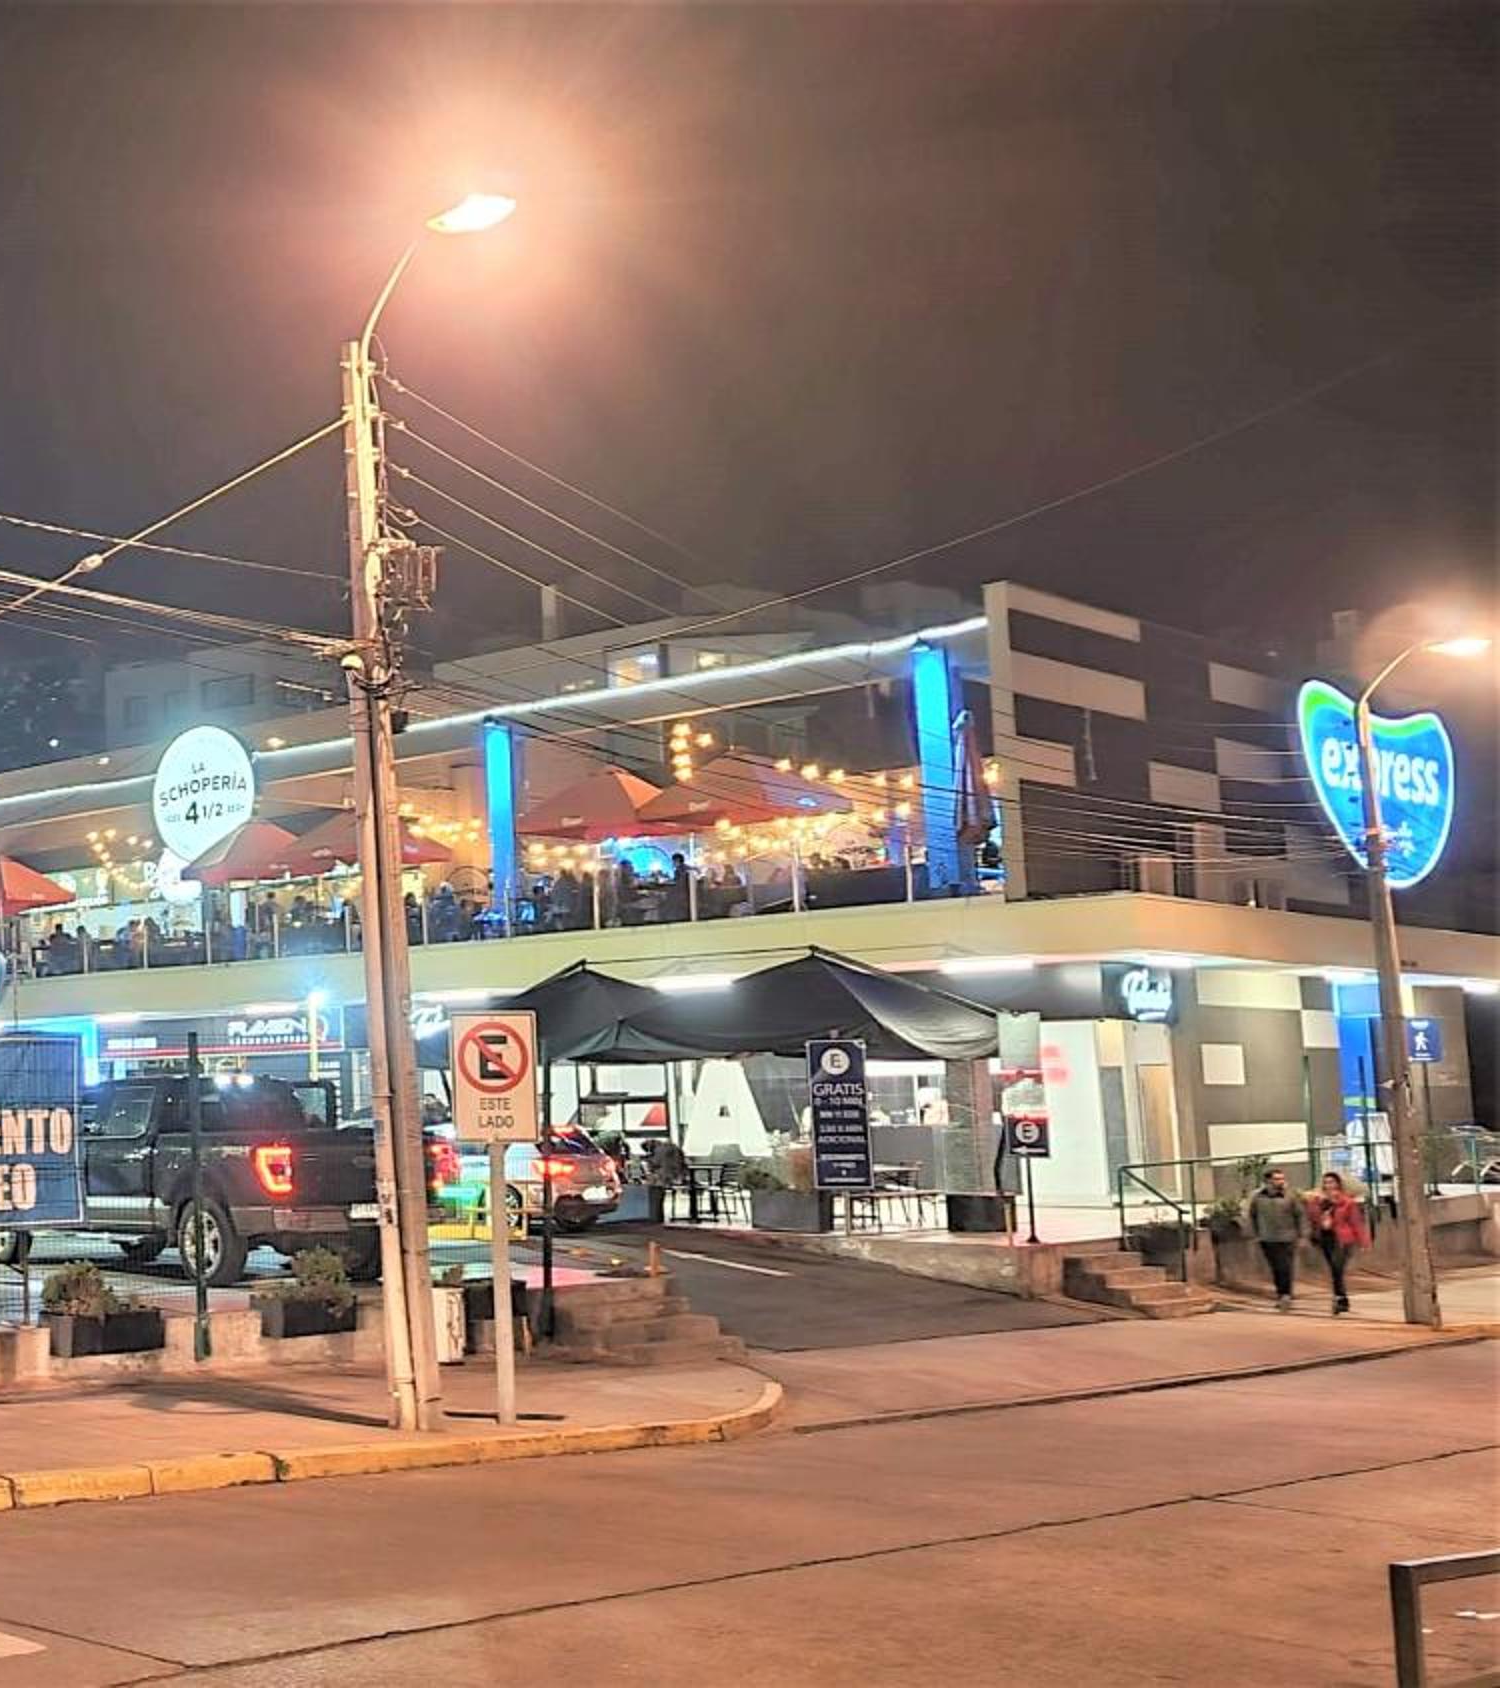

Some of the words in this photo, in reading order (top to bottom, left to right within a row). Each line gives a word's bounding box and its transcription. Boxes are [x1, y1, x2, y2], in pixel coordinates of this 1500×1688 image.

[184, 801, 200, 825] 4
[813, 1083, 864, 1097] GRATIS
[480, 1097, 511, 1110] ESTE
[478, 1115, 514, 1129] LADO
